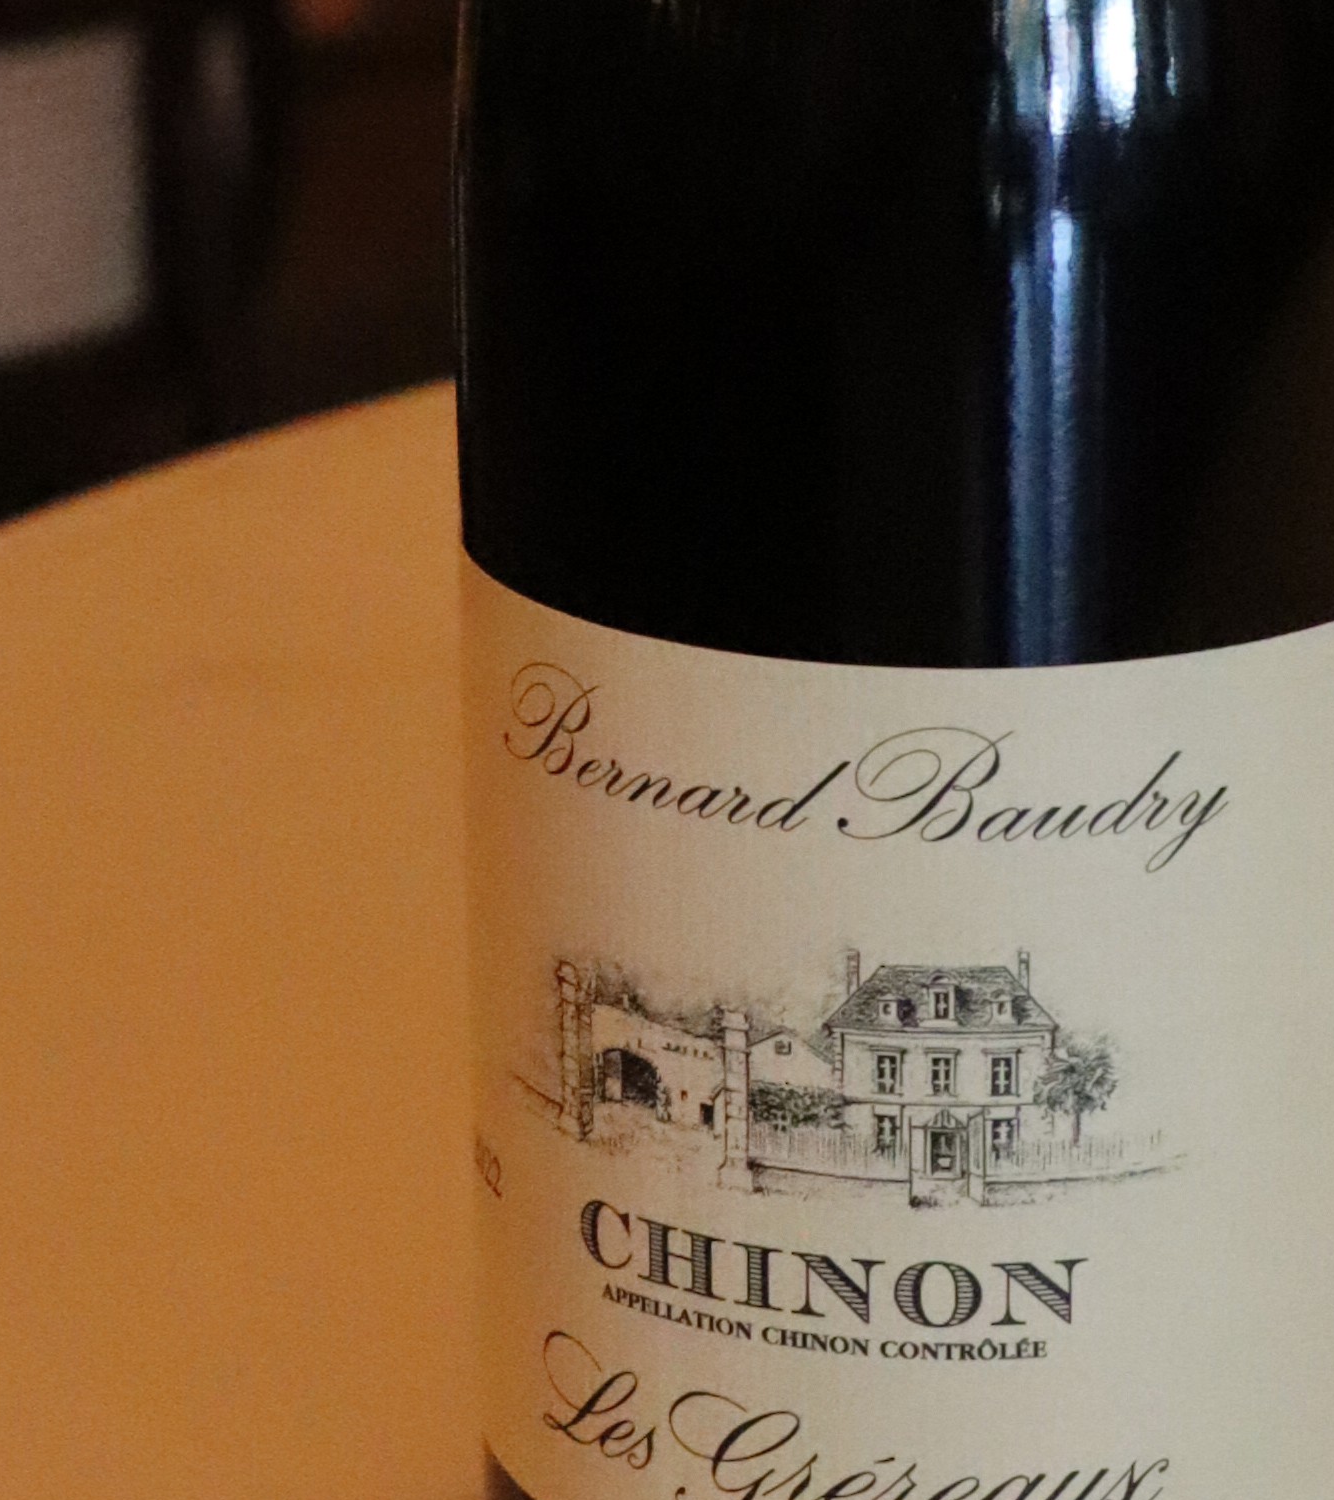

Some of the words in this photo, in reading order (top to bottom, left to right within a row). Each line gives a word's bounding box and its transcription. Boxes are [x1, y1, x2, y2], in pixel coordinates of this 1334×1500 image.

[504, 662, 851, 832] Bernard
[836, 726, 1229, 873] Baudry
[580, 1199, 1089, 1328] CHINON
[600, 1282, 753, 1341] APPELLATION
[760, 1326, 871, 1358] CHINON
[879, 1337, 1048, 1361] CONTRÔLÉE
[542, 1330, 657, 1470] Les
